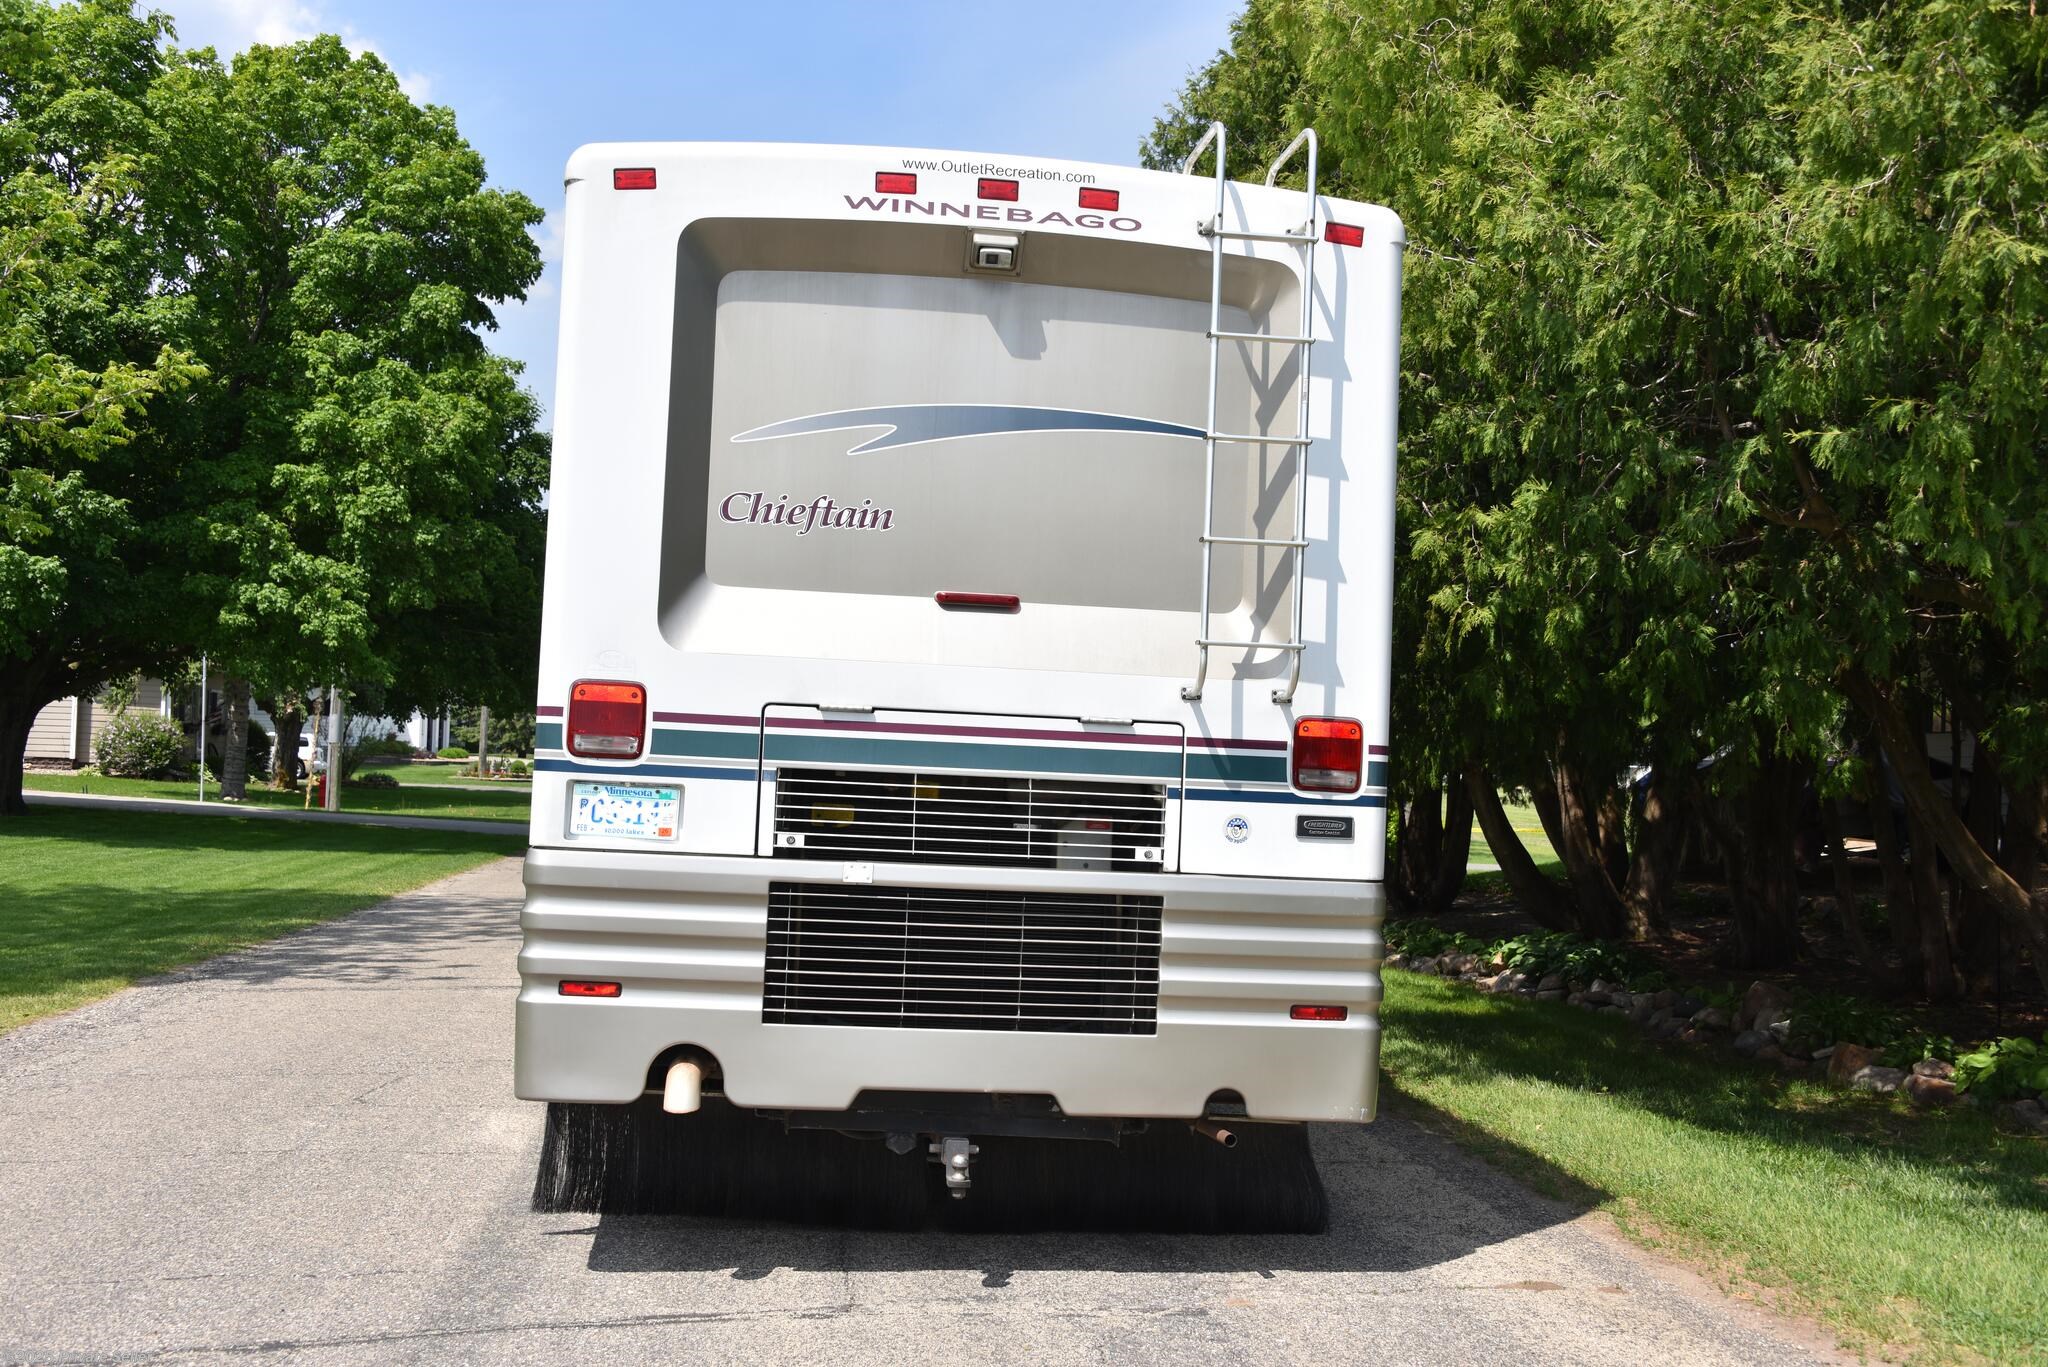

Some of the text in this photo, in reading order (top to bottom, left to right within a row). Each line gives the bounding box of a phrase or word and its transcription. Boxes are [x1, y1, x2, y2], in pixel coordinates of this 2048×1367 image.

[901, 157, 1096, 184] www.OutletRecreation.com
[843, 195, 1142, 232] WINNEBAGO
[719, 491, 895, 536] Chieftain
